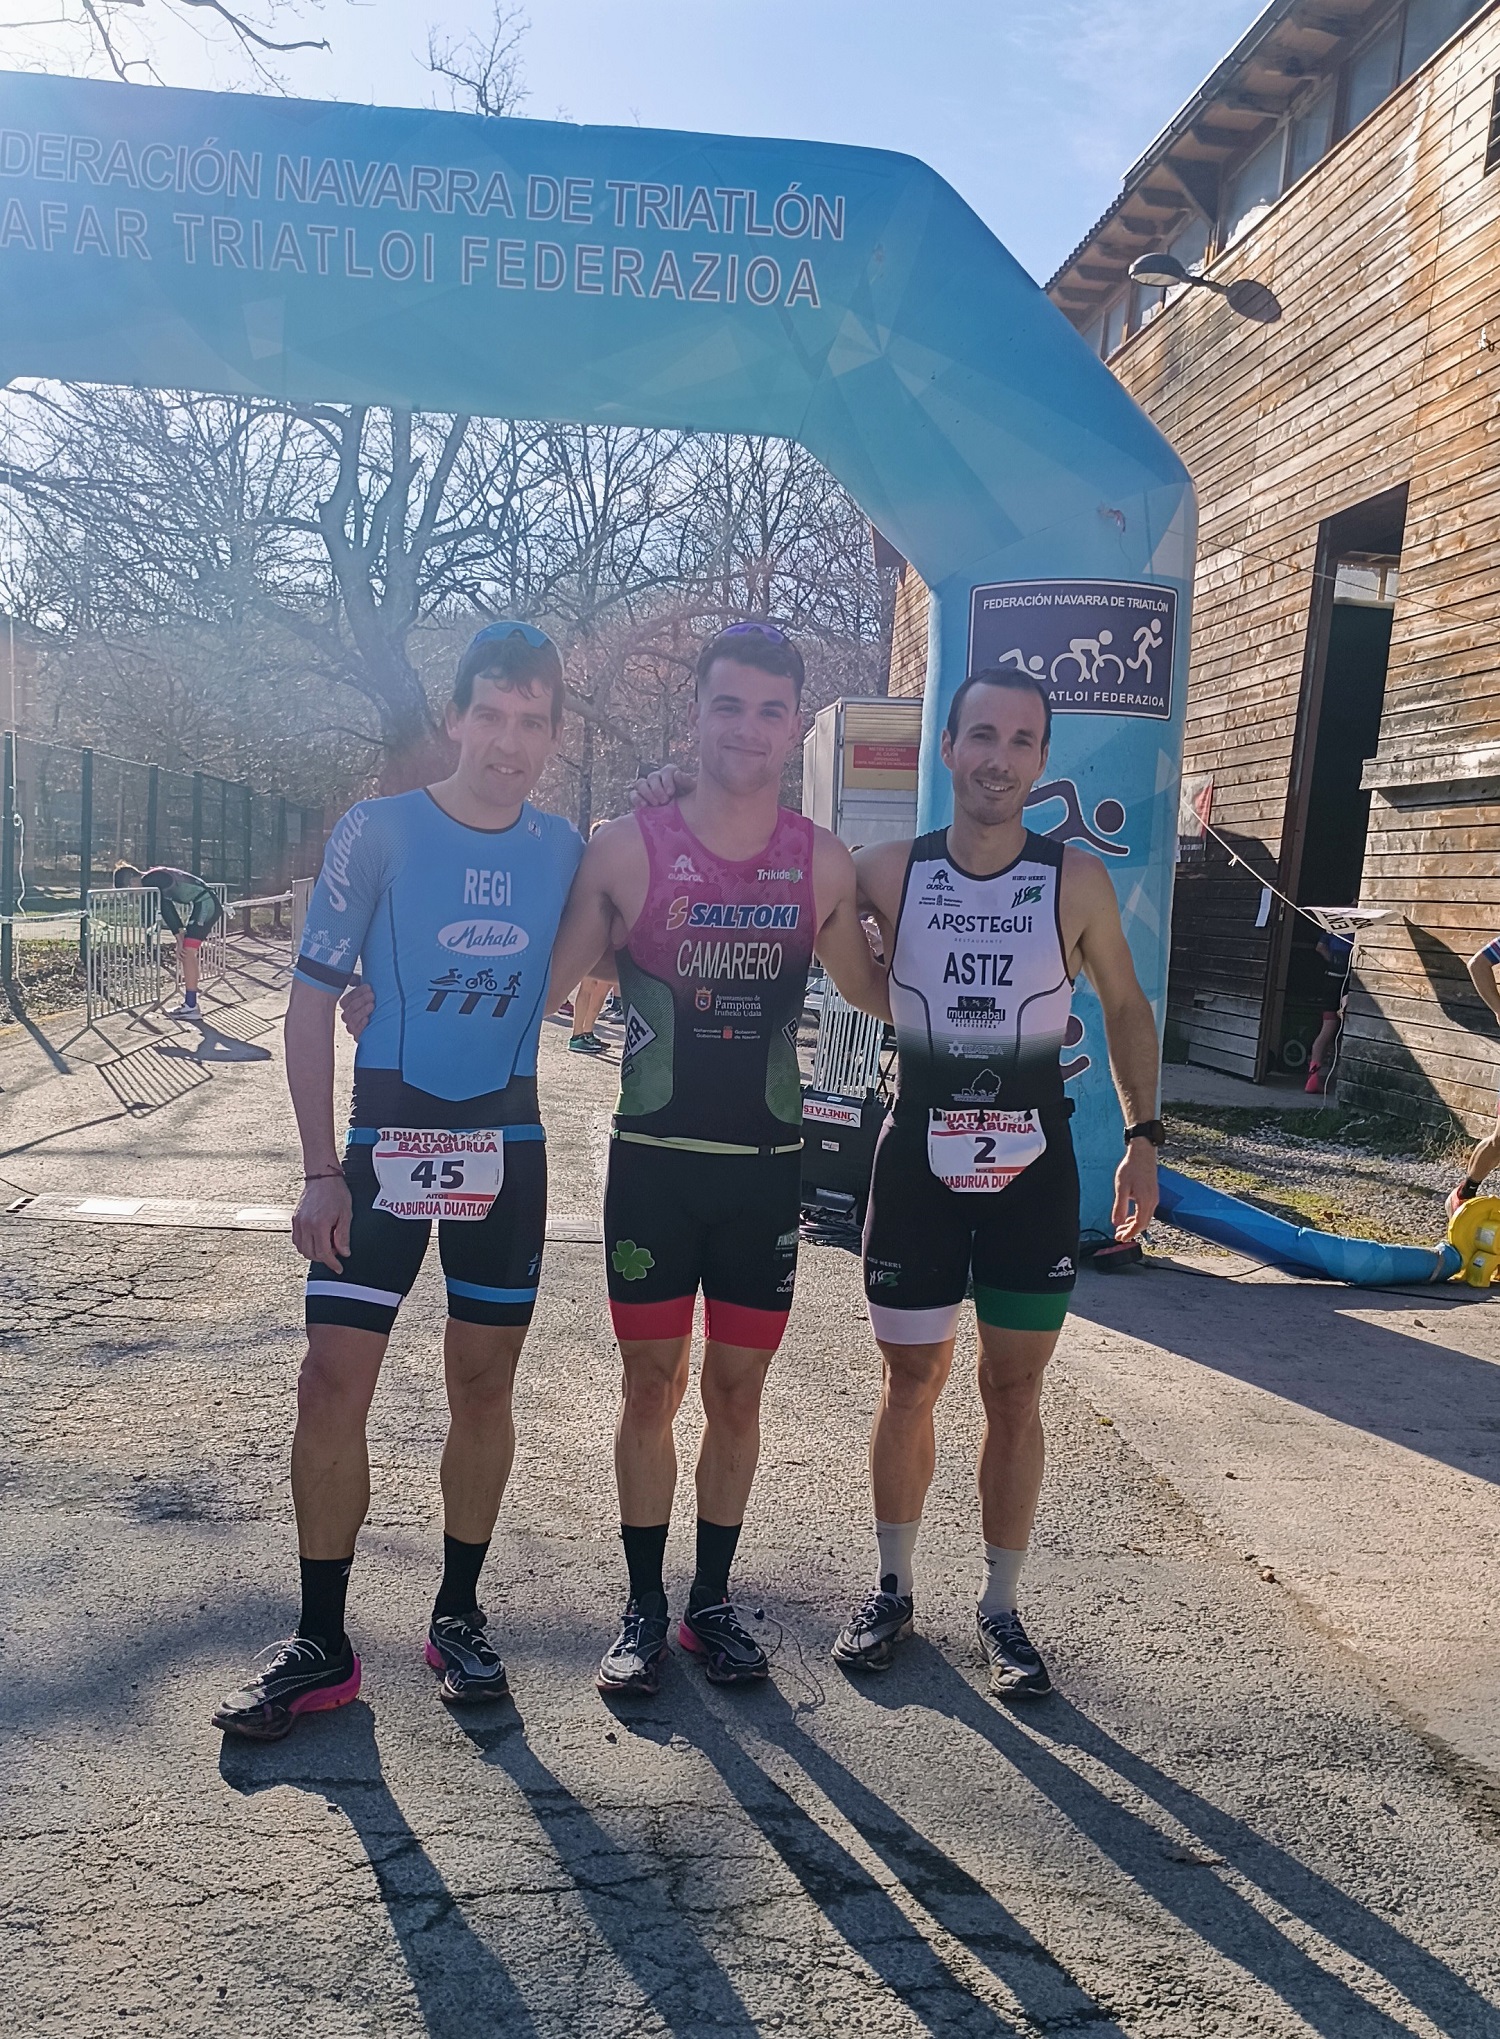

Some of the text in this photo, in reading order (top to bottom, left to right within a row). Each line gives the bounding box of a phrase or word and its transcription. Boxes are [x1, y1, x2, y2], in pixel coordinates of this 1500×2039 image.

[274, 154, 516, 219] NAVARRA
[526, 174, 594, 224] DE
[606, 181, 845, 241] TRIATLÓN
[173, 212, 434, 283] TRIATLOI
[461, 235, 821, 308] FEDERAZIOA
[983, 593, 1169, 612] FEDERACIÓN NAVARRA DE TRIATLÓN
[1093, 691, 1165, 708] FEDERAZIOA
[322, 807, 369, 912] Mahala
[463, 868, 512, 906] REGI
[688, 903, 800, 930] SALTOKI
[447, 925, 518, 949] Mahala
[676, 939, 783, 980] CAMARERO
[943, 952, 1014, 986] ASTIZ
[715, 1000, 761, 1011] Pamplona
[948, 1008, 1004, 1021] muruzabal
[398, 1141, 498, 1154] BASABURUA
[973, 1136, 997, 1163] 2
[410, 1159, 465, 1189] 45
[379, 1198, 441, 1215] BASABURUA
